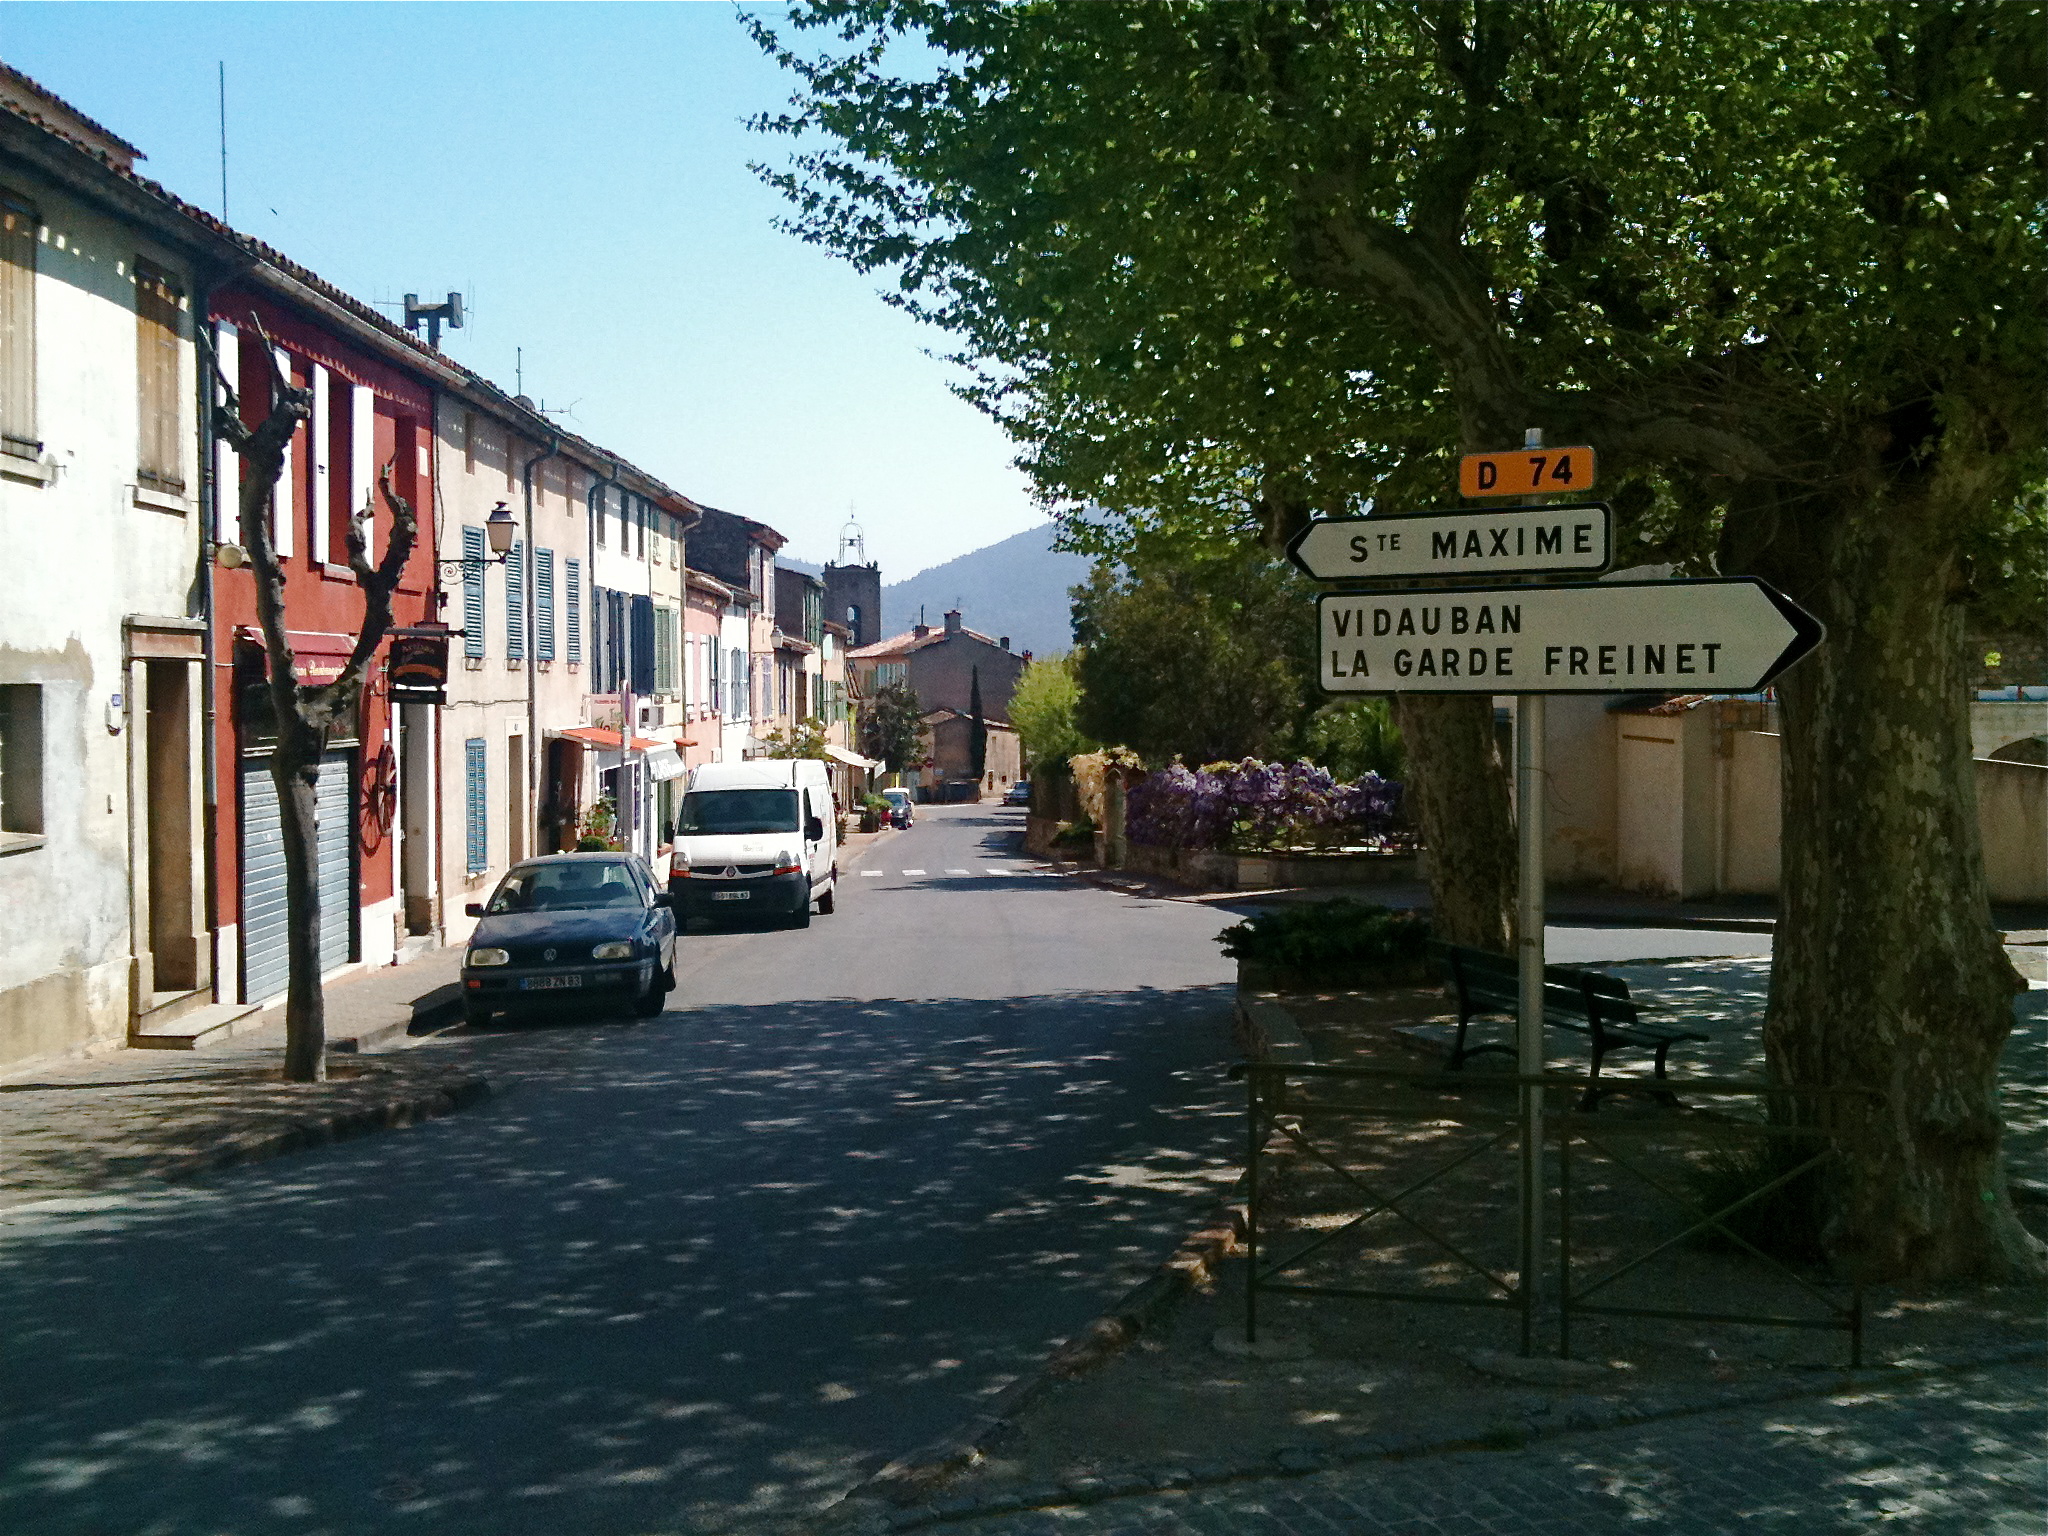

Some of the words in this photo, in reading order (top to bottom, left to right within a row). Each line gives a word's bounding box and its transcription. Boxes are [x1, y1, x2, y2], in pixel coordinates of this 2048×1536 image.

[1477, 459, 1498, 491] D
[1527, 454, 1574, 487] 74
[1431, 523, 1593, 560] MAXIME
[1331, 604, 1521, 638] VIDAUBAN
[1331, 649, 1370, 678] LA
[1393, 646, 1514, 678] GARDE
[1544, 642, 1722, 676] FREINET
